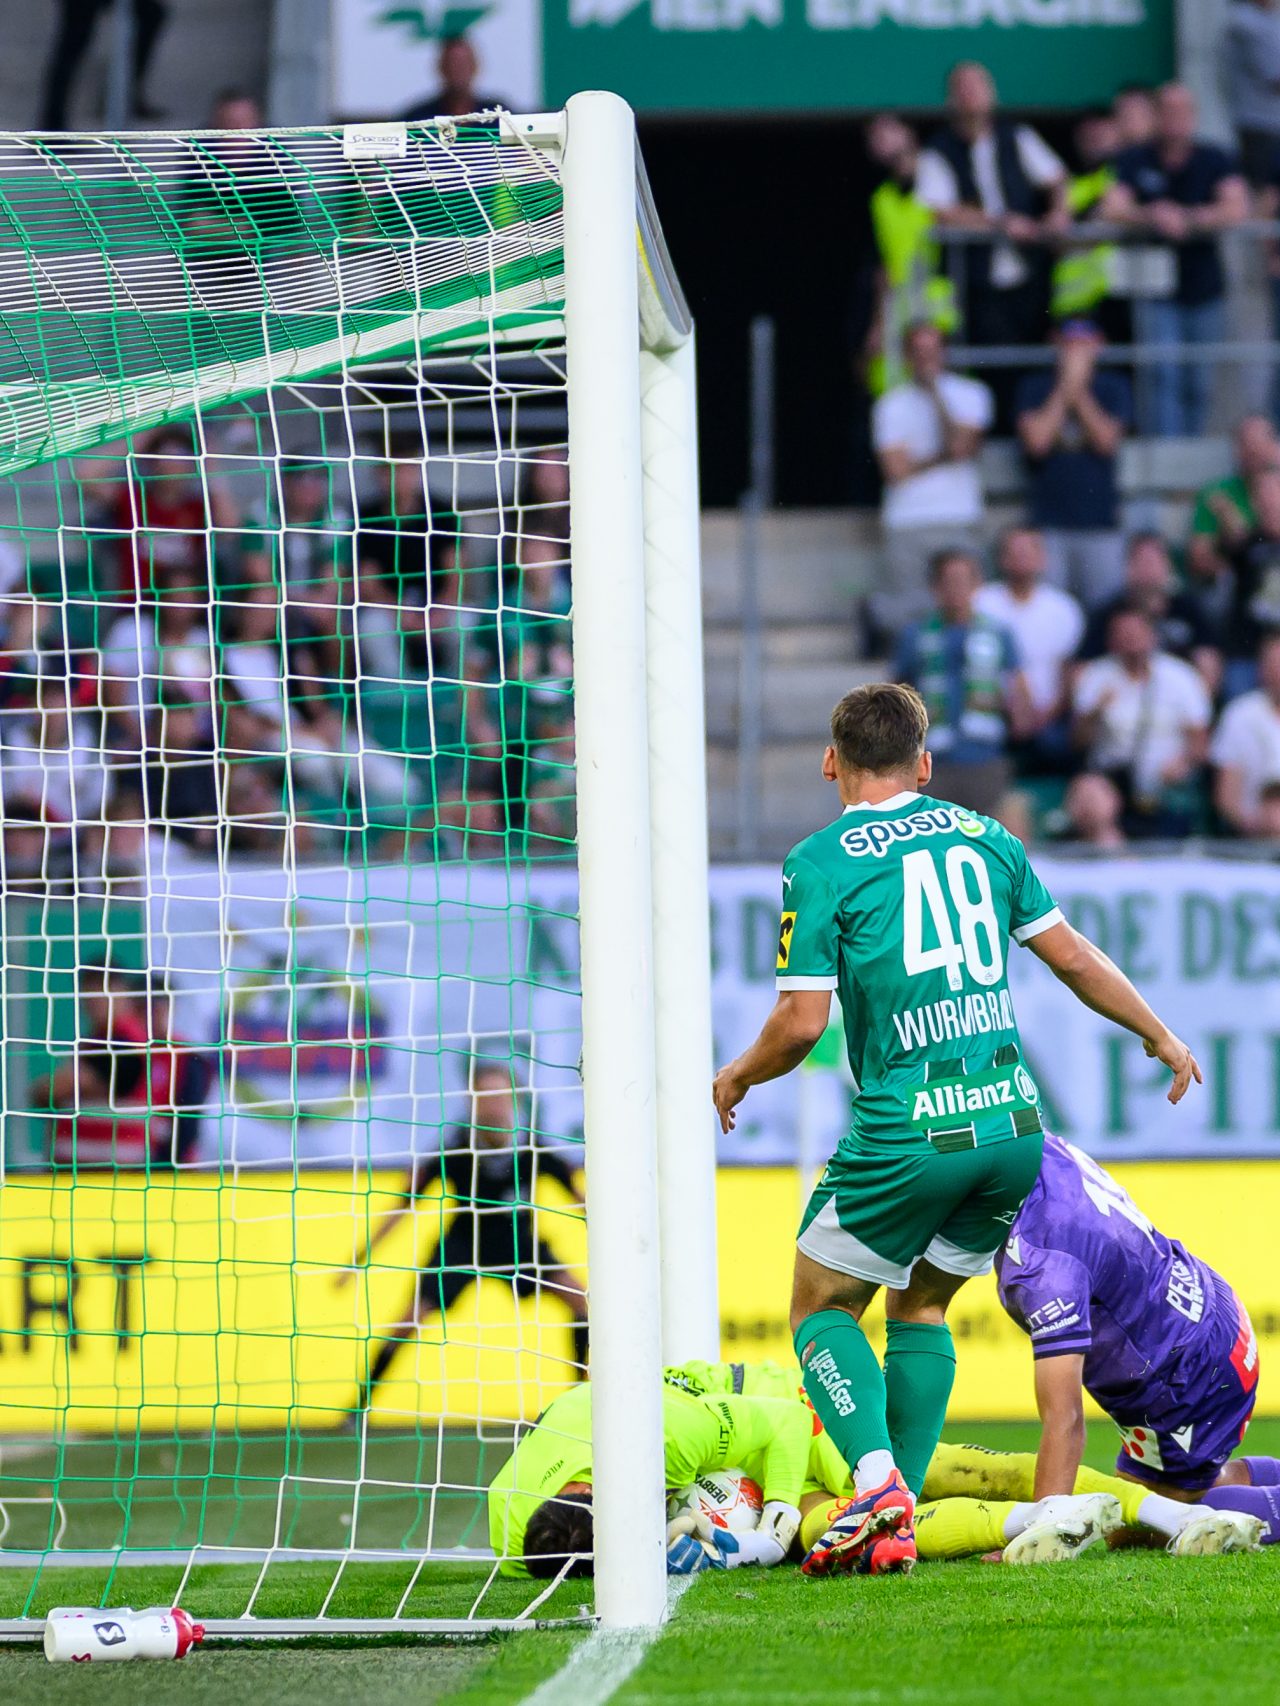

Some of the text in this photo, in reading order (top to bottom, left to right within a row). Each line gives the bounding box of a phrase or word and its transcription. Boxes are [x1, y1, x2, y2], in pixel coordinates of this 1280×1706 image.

[841, 807, 954, 857] spusu
[902, 845, 1003, 991] 48
[912, 1079, 1016, 1121] Allianz
[0, 1253, 152, 1355] RT
[807, 1348, 857, 1417] easystaff
